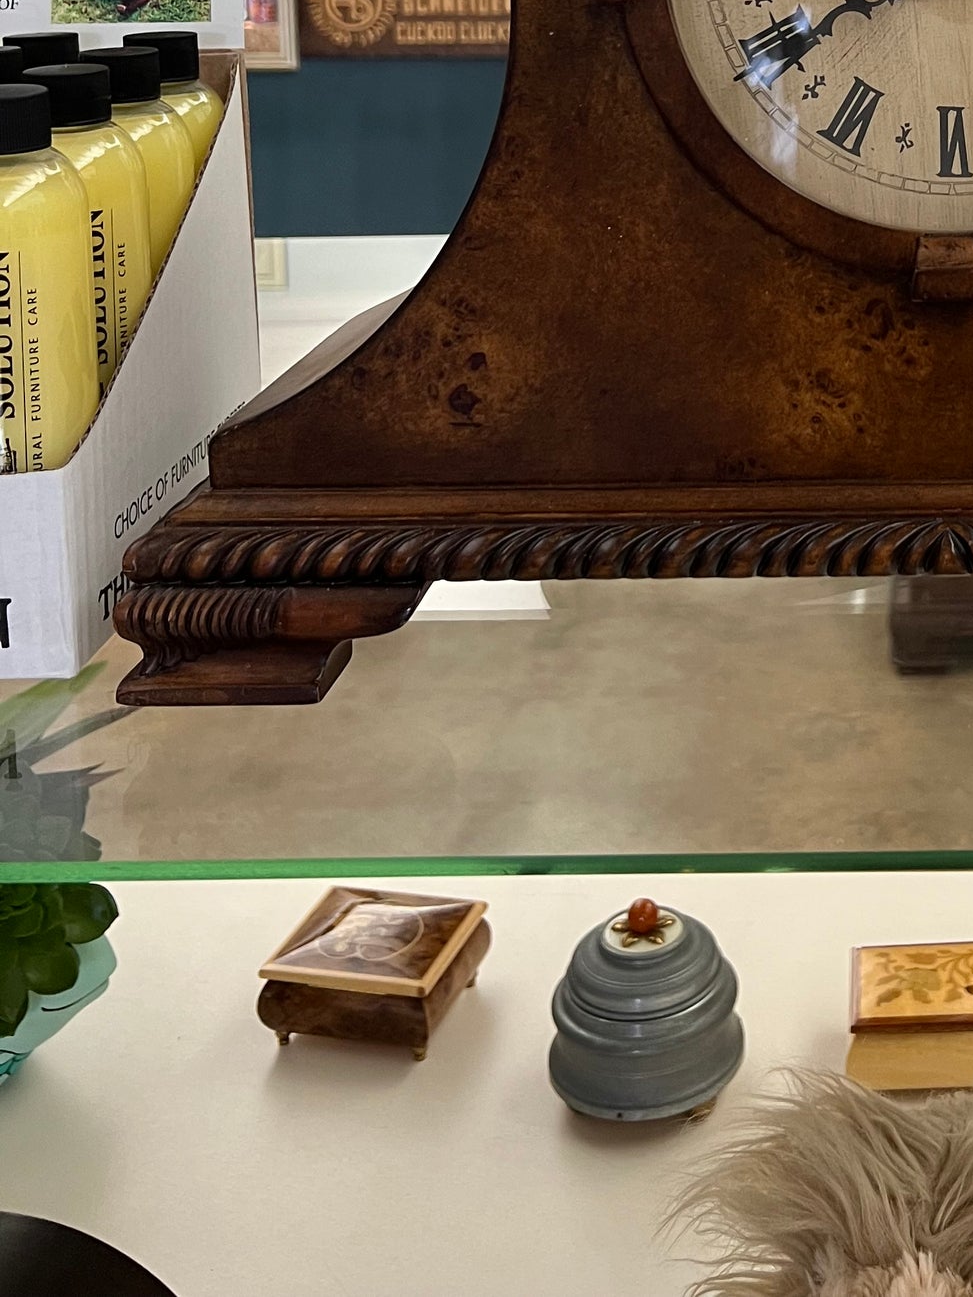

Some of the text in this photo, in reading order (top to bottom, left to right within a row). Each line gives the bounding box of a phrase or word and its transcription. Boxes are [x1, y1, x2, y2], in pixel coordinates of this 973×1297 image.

[117, 242, 126, 277] CARE
[27, 287, 38, 326] CARE
[26, 336, 42, 421] FURNITURE
[114, 429, 215, 540] CHOICE OF FURNITU
[98, 570, 130, 622] TH
